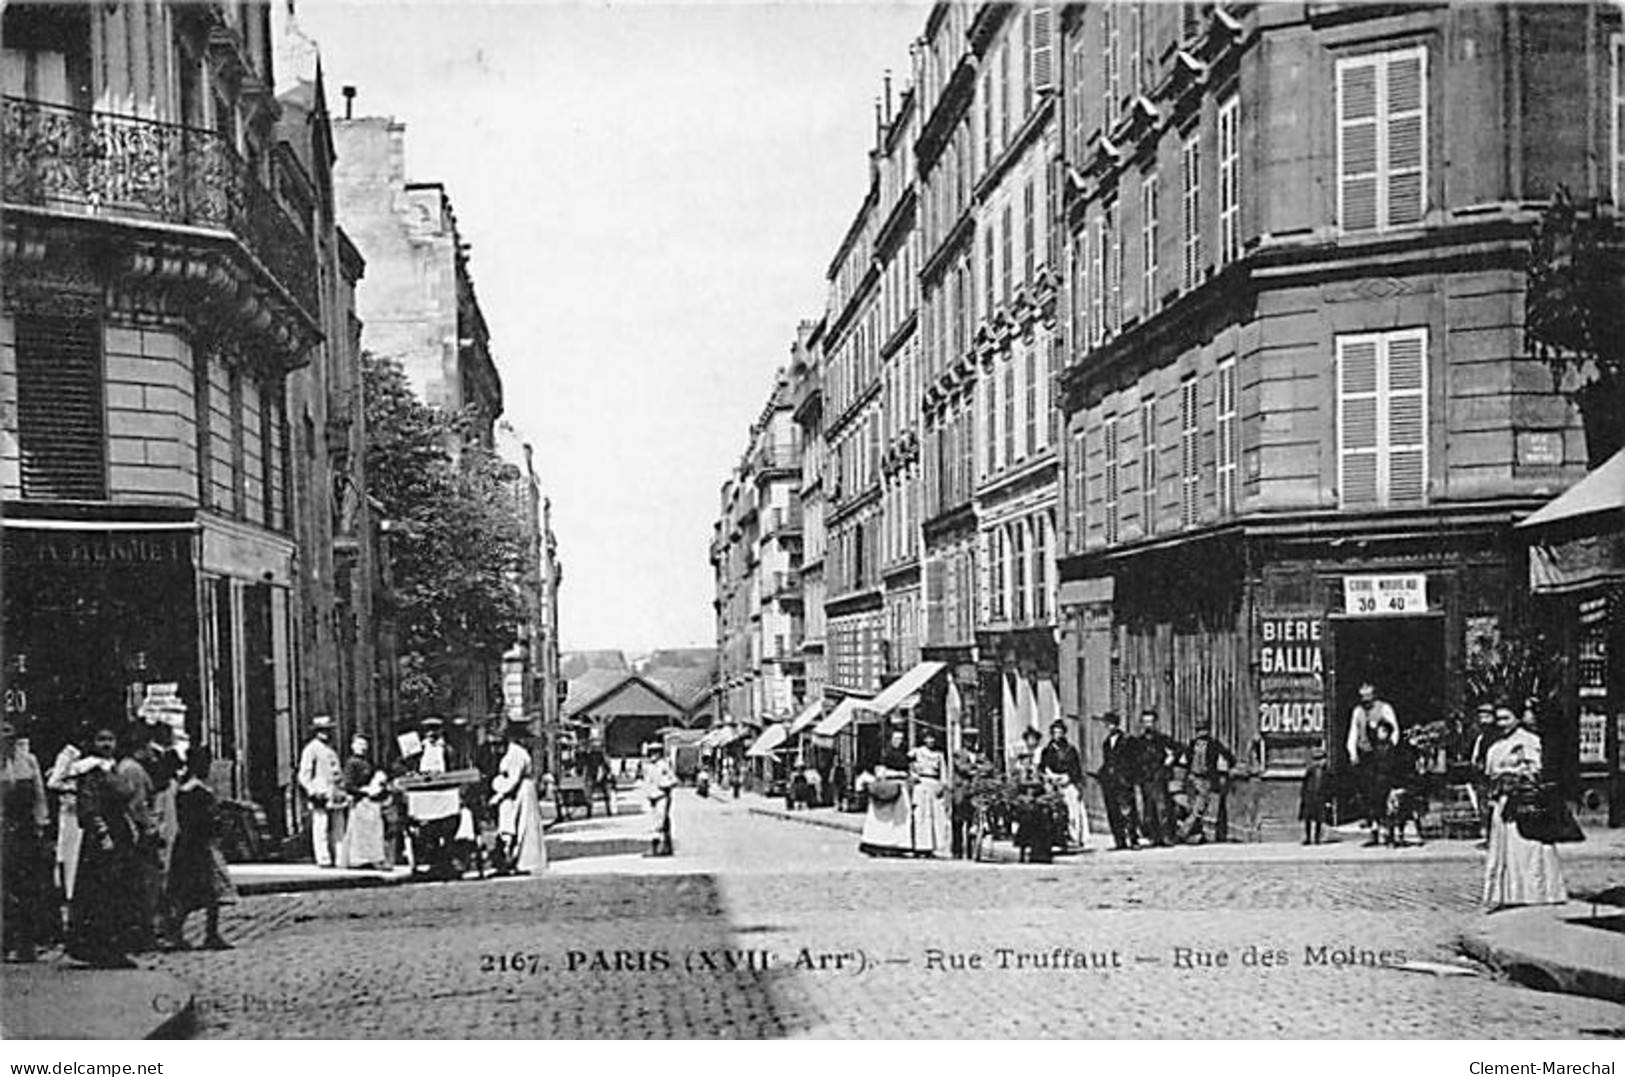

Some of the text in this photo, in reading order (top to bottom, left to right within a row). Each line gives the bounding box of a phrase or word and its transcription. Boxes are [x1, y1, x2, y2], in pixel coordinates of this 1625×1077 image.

[1358, 597, 1405, 612] 30 40
[1261, 648, 1323, 673] GALLIA
